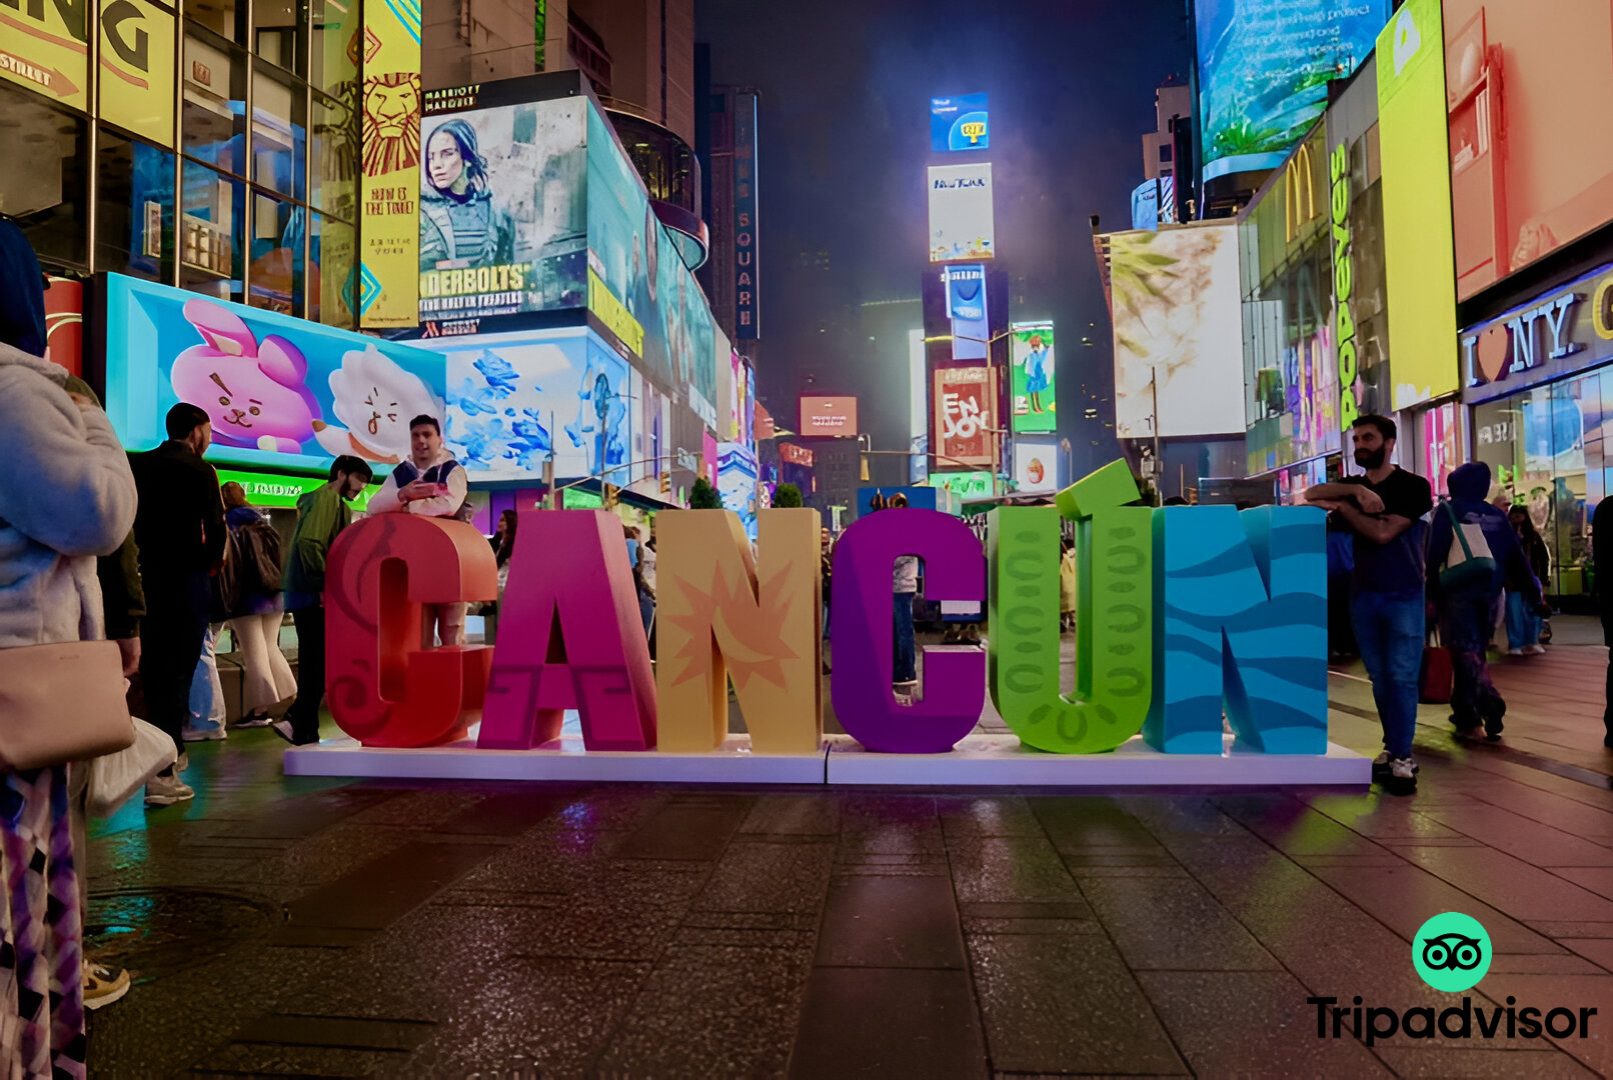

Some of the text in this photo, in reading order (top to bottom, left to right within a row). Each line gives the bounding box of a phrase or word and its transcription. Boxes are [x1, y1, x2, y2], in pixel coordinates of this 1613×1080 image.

[425, 84, 480, 99] MARRIOTT
[736, 212, 751, 326] SQUARE
[1331, 143, 1360, 433] POPEYES
[324, 457, 1328, 756] CANCÚN
